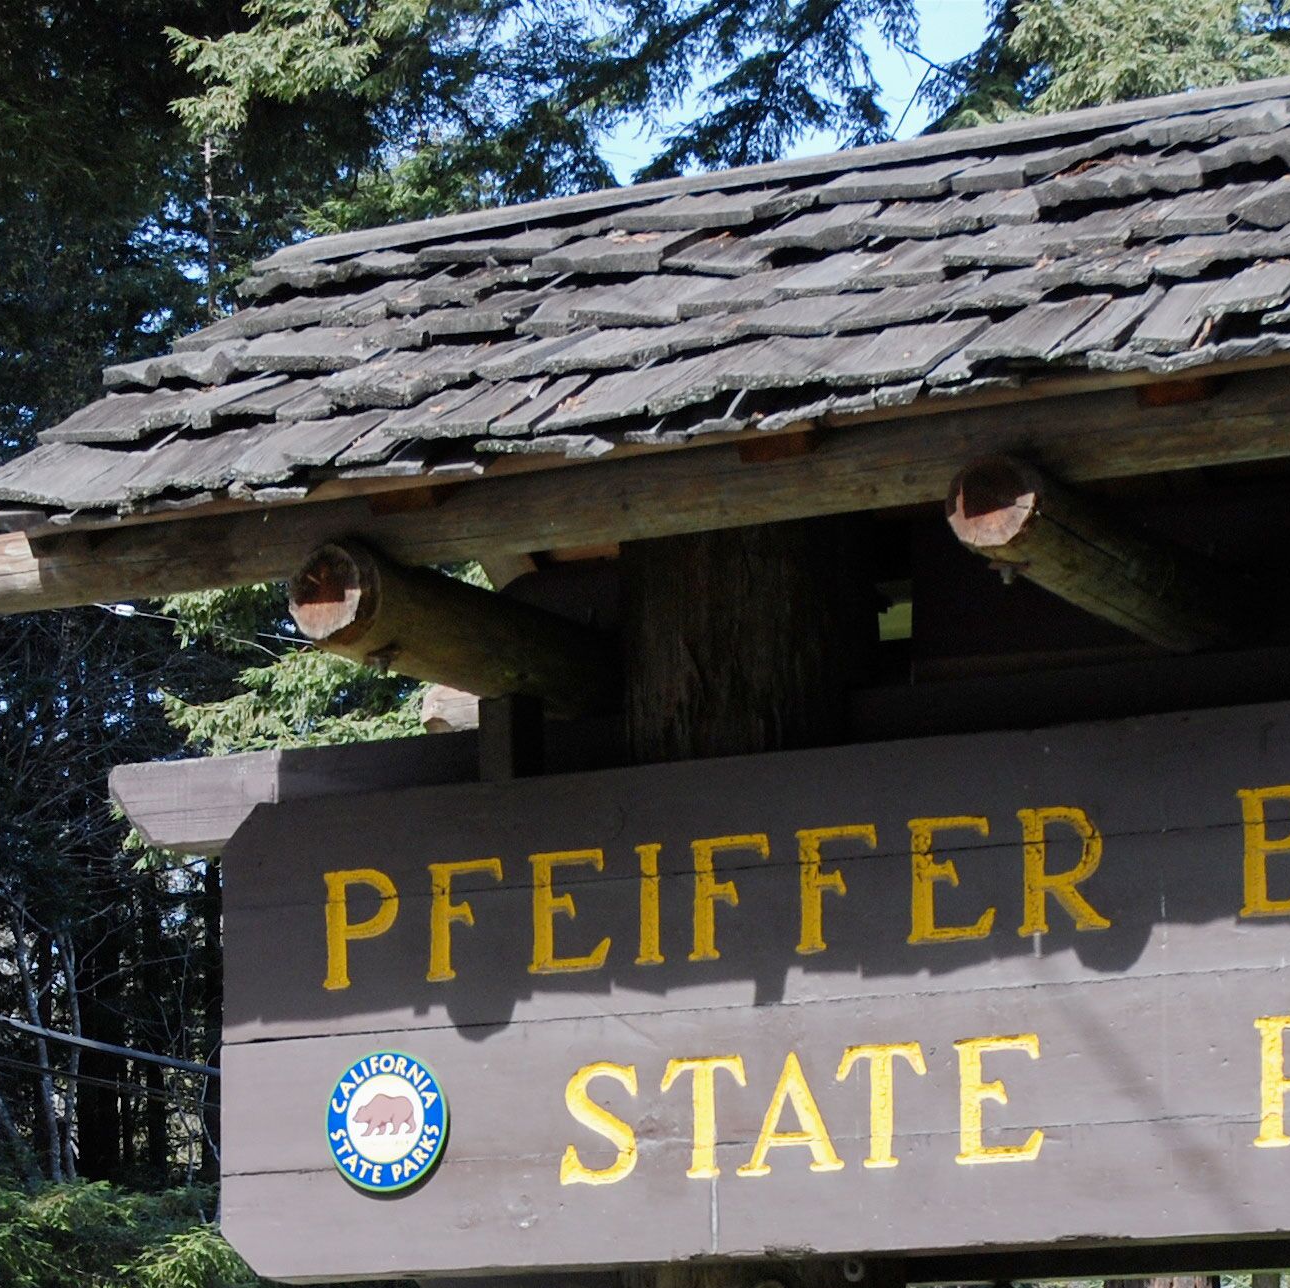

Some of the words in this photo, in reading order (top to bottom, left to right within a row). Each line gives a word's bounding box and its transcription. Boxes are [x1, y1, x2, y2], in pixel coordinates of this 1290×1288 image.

[323, 807, 1110, 990] PFEIFFER
[331, 1054, 438, 1114] CALIFORNIA
[560, 1033, 1045, 1184] STATE
[330, 1128, 384, 1184] STATE
[391, 1124, 440, 1182] PARKS
